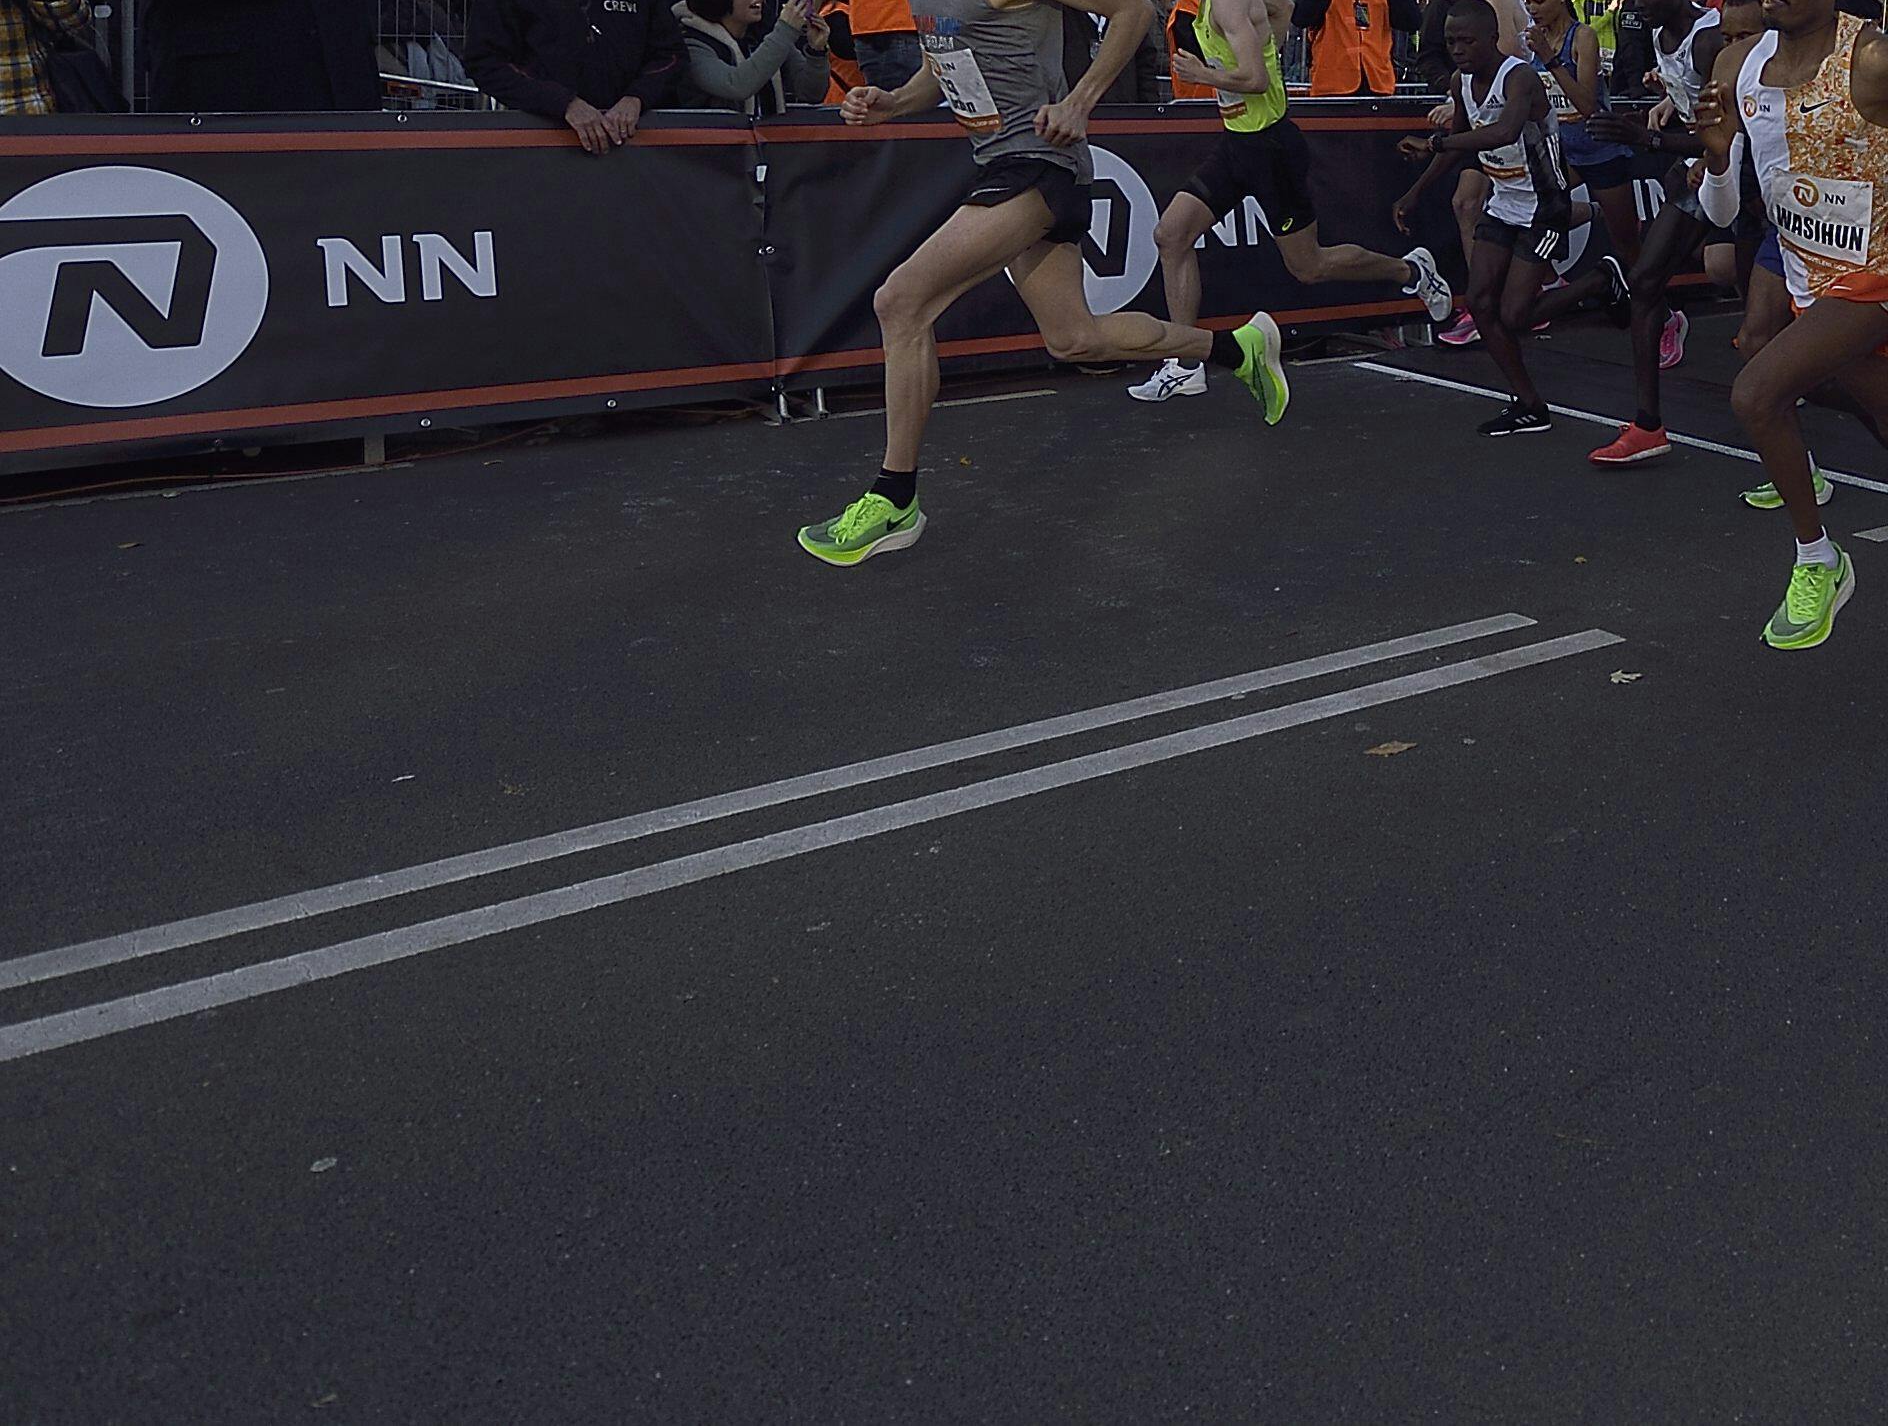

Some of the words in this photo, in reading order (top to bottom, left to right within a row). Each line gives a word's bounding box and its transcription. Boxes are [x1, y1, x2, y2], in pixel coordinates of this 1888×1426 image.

[1824, 193, 1847, 206] NN
[1775, 204, 1865, 252] WASIHUN
[317, 230, 498, 307] NN
